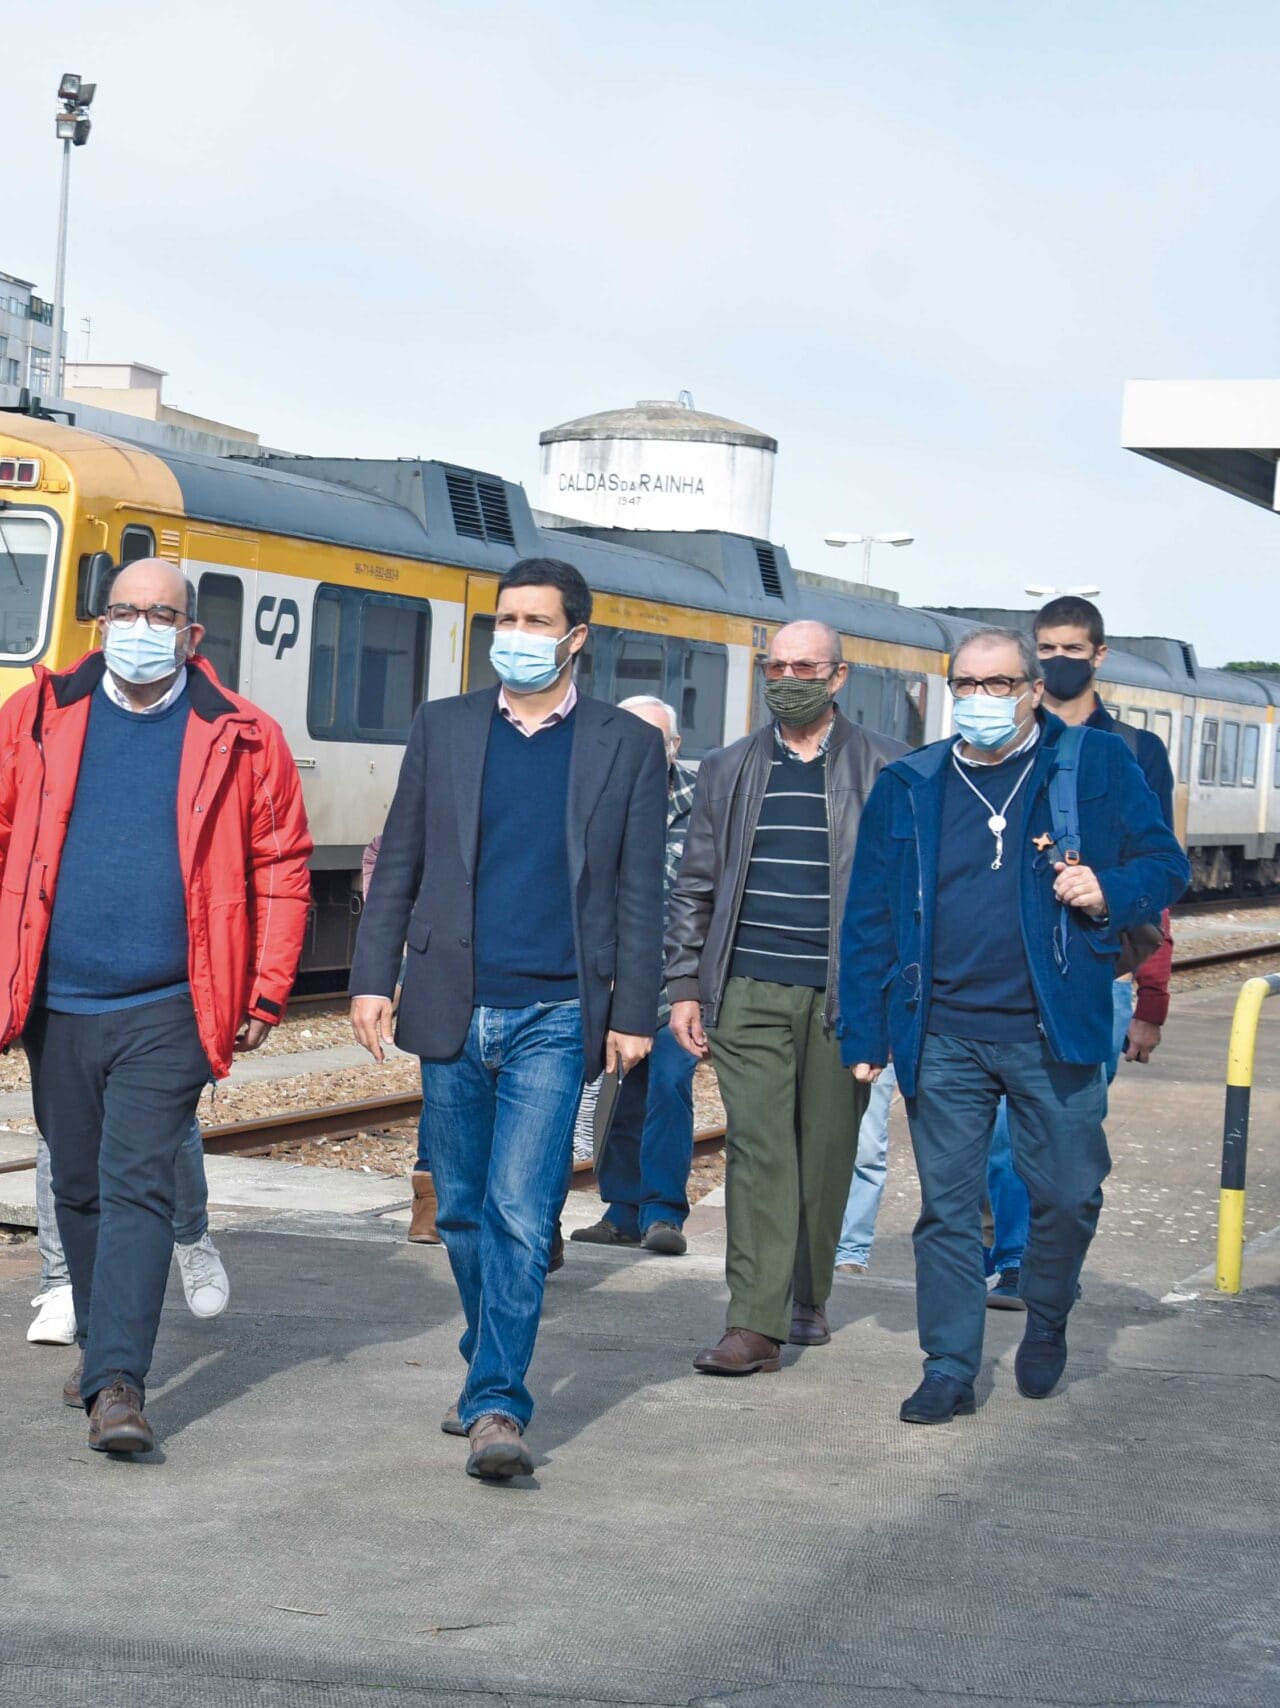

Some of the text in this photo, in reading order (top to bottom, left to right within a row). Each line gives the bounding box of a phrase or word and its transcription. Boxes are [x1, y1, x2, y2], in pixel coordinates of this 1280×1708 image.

[559, 472, 620, 492] CALDAS
[639, 473, 705, 495] RAINHA
[255, 595, 300, 660] CP
[449, 622, 458, 664] 1
